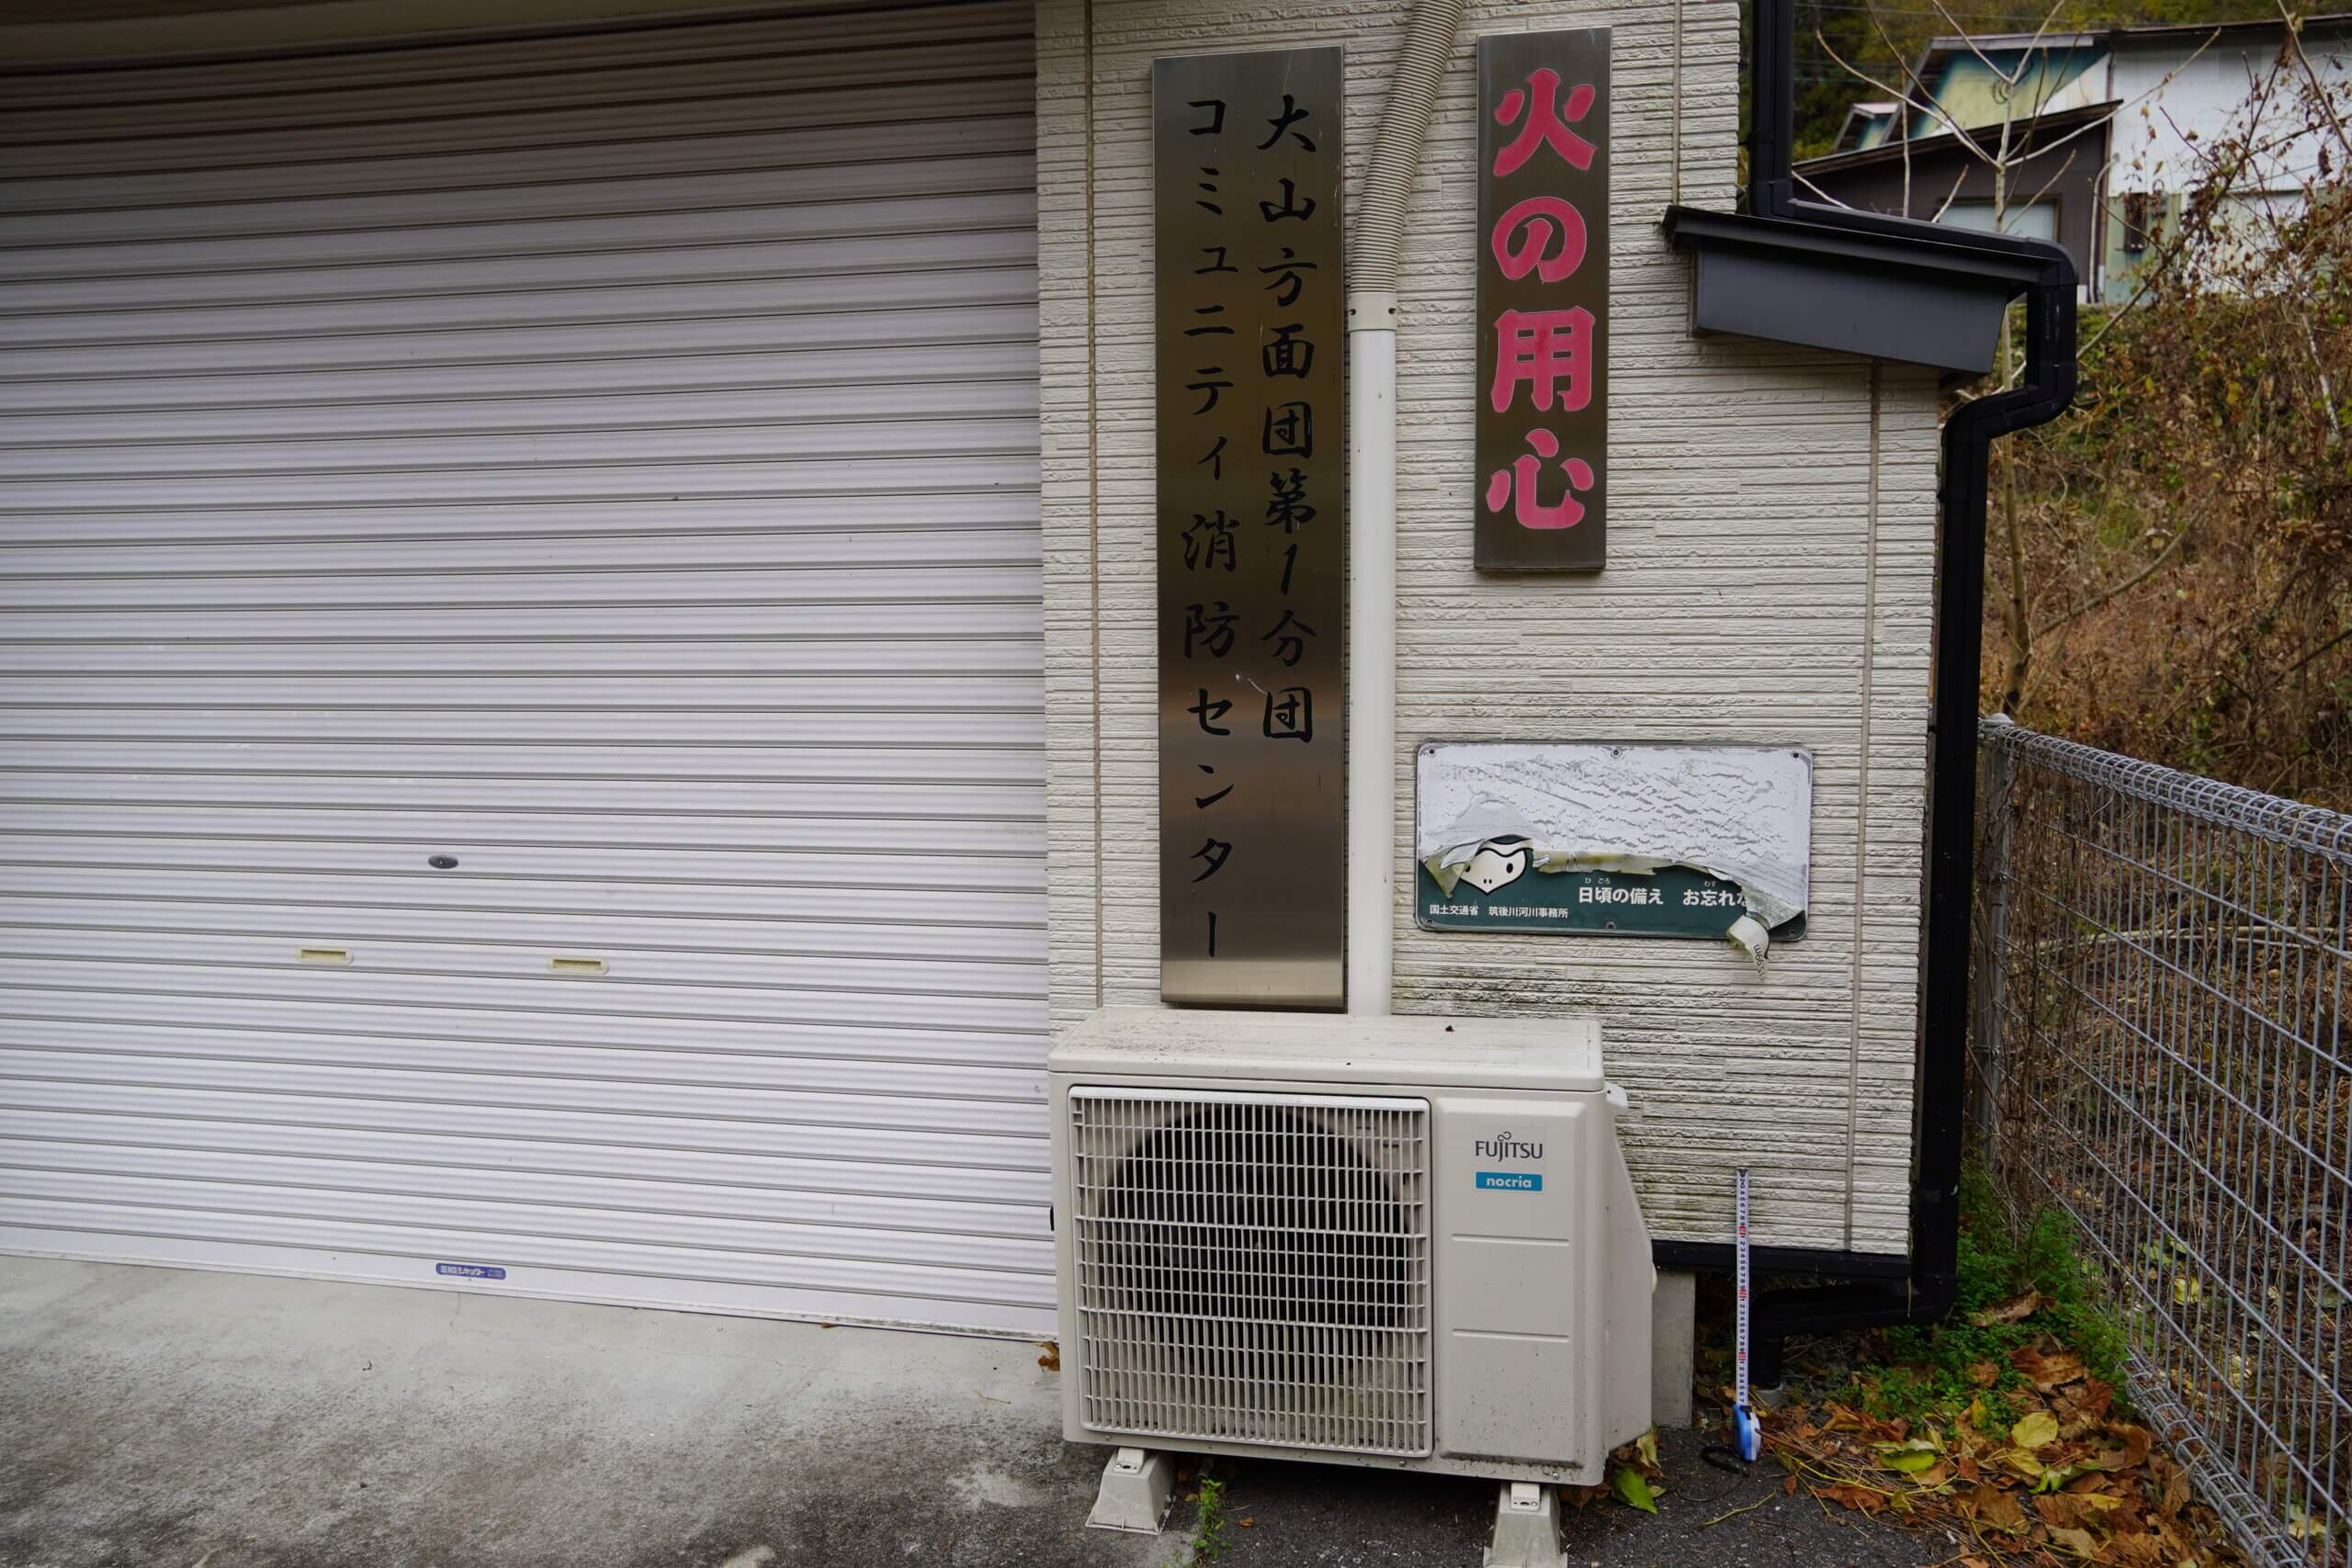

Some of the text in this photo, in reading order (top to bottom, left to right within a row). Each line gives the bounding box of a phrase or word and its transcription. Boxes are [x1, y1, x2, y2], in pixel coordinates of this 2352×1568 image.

[1486, 68, 1597, 529] 火の用心
[1578, 886, 1664, 905] 日頃の備え
[1430, 904, 1568, 919] 国土交通省 筑後川河川事務所
[1476, 1131, 1543, 1162] FUJITSU
[1487, 1176, 1532, 1188] nocria
